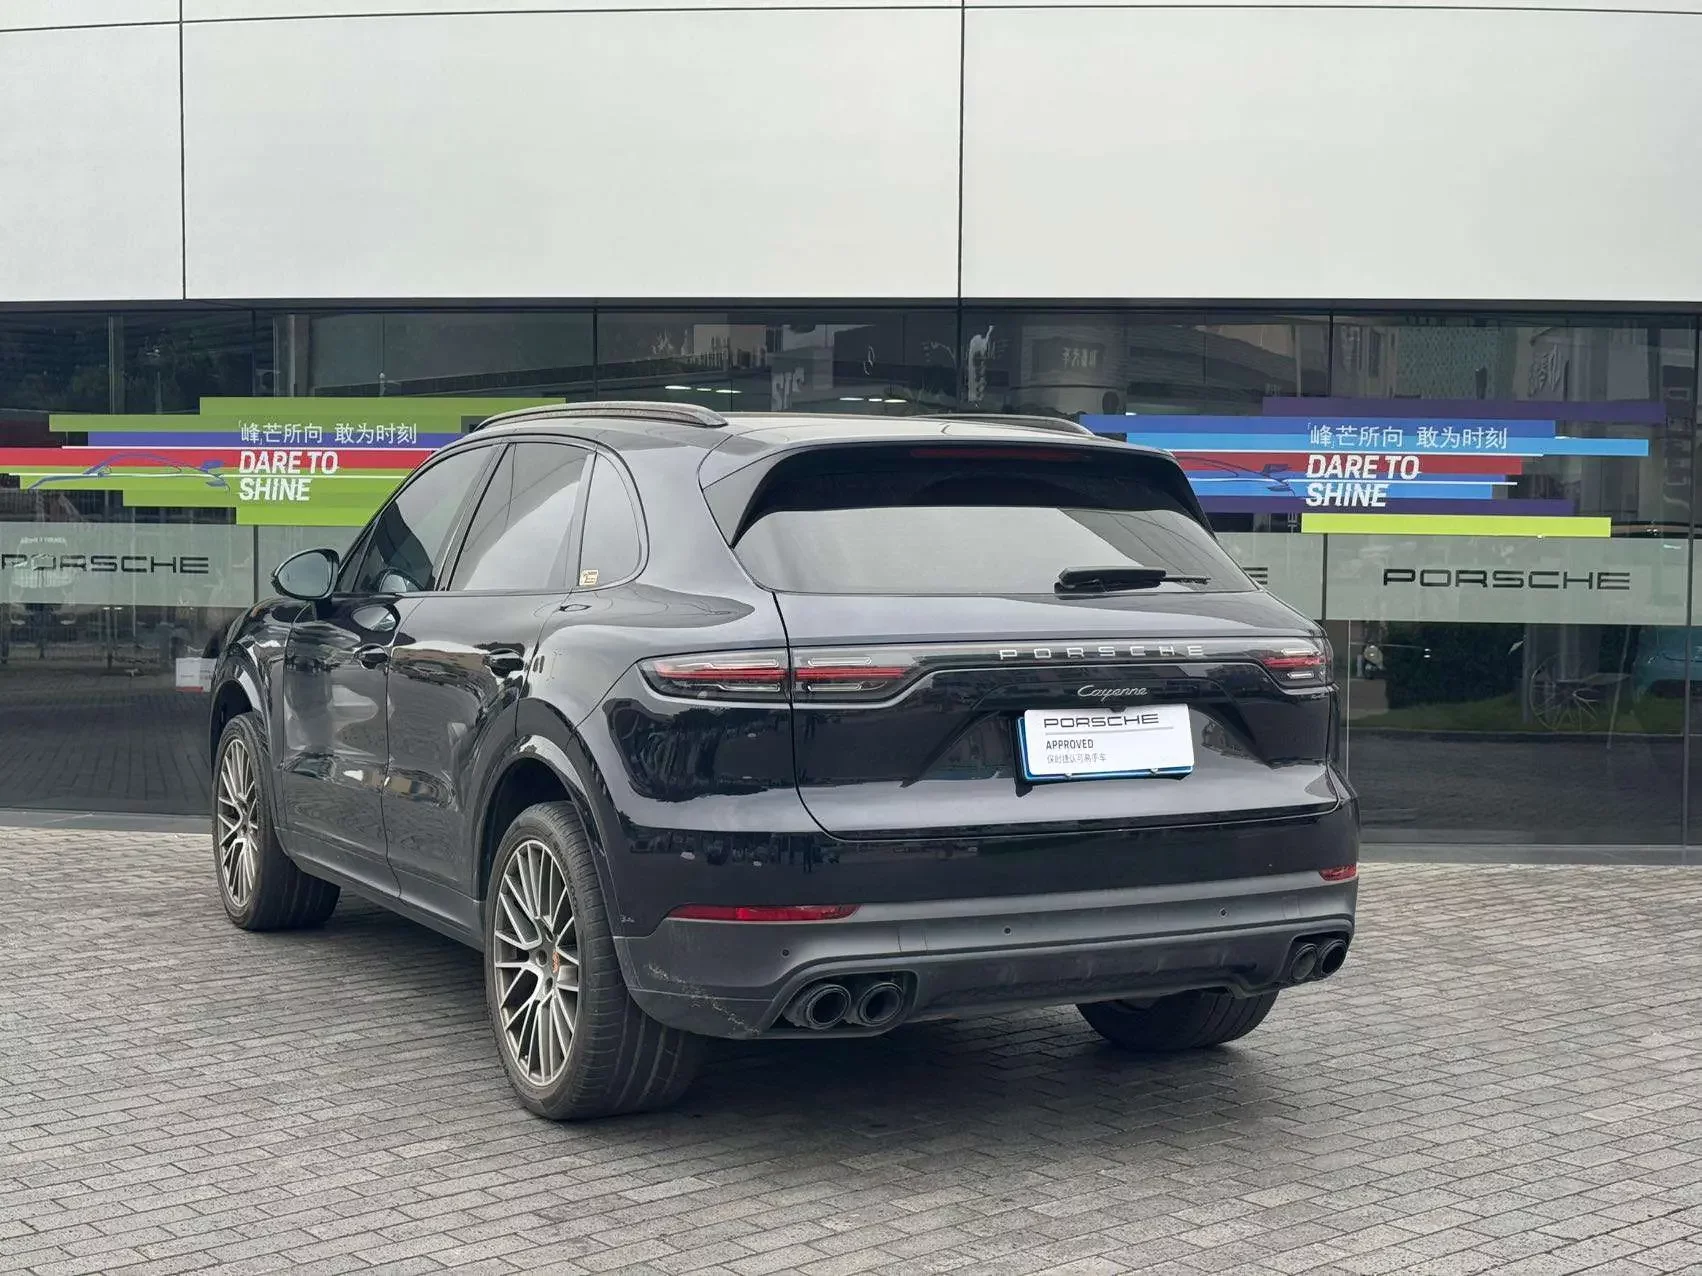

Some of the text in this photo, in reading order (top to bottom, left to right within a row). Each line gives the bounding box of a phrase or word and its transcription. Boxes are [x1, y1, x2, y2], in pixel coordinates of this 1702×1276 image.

[335, 423, 417, 444] 敢为时刻
[1416, 426, 1507, 449] 敢为时刻
[239, 451, 339, 475] DARE TO
[1306, 454, 1421, 480] DARE TO
[239, 477, 313, 501] SHINE
[1305, 483, 1390, 507] SHINE
[1, 553, 209, 575] PORSCHE
[1383, 568, 1631, 590] PORSCHE
[1000, 645, 1204, 660] PORSCHE
[1077, 684, 1149, 702] Cayenne
[1044, 713, 1160, 728] PORSCHE
[1046, 738, 1094, 750] APPROVED
